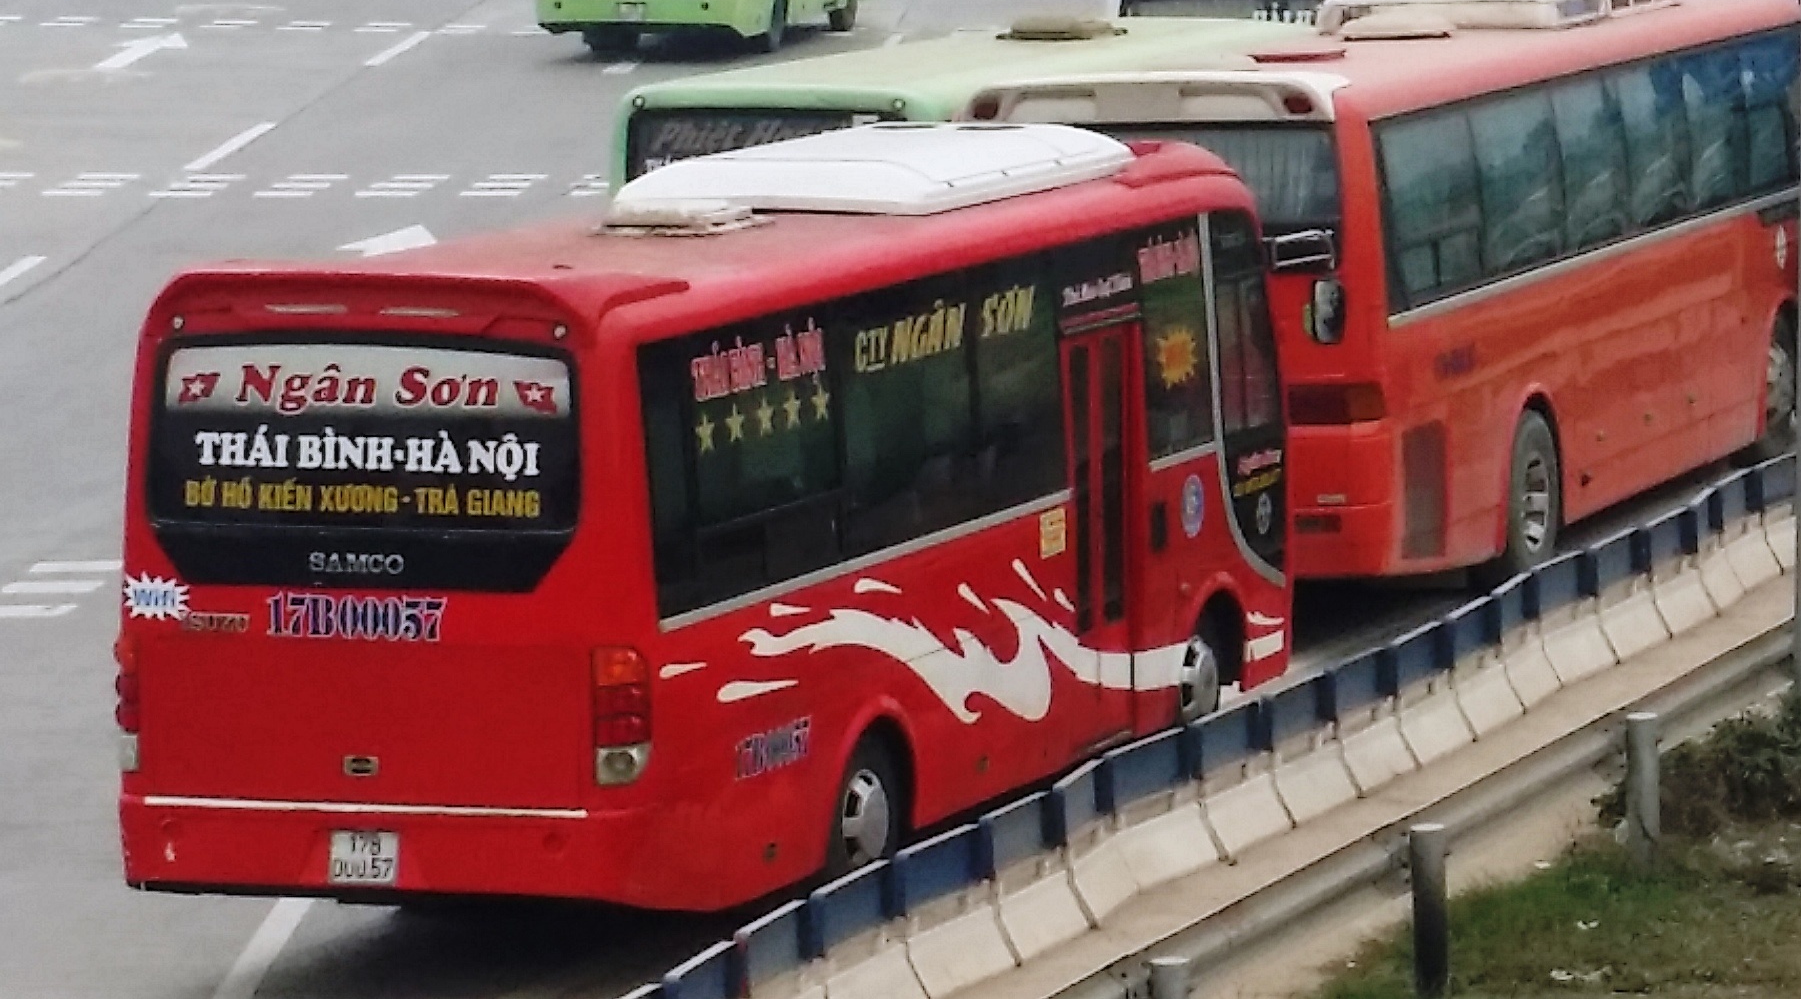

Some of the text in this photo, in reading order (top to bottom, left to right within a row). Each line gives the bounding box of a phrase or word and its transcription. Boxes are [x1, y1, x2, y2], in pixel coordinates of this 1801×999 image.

[892, 299, 967, 365] NGÂN
[981, 284, 1035, 338] SƠN
[234, 362, 499, 414] Ngân Sơn
[195, 424, 290, 468] THÁI
[467, 432, 541, 482] NỘI
[258, 477, 312, 512] KIẾN
[467, 488, 542, 519] GIANG
[308, 551, 405, 575] SAMCO
[266, 589, 448, 643] 17B00057
